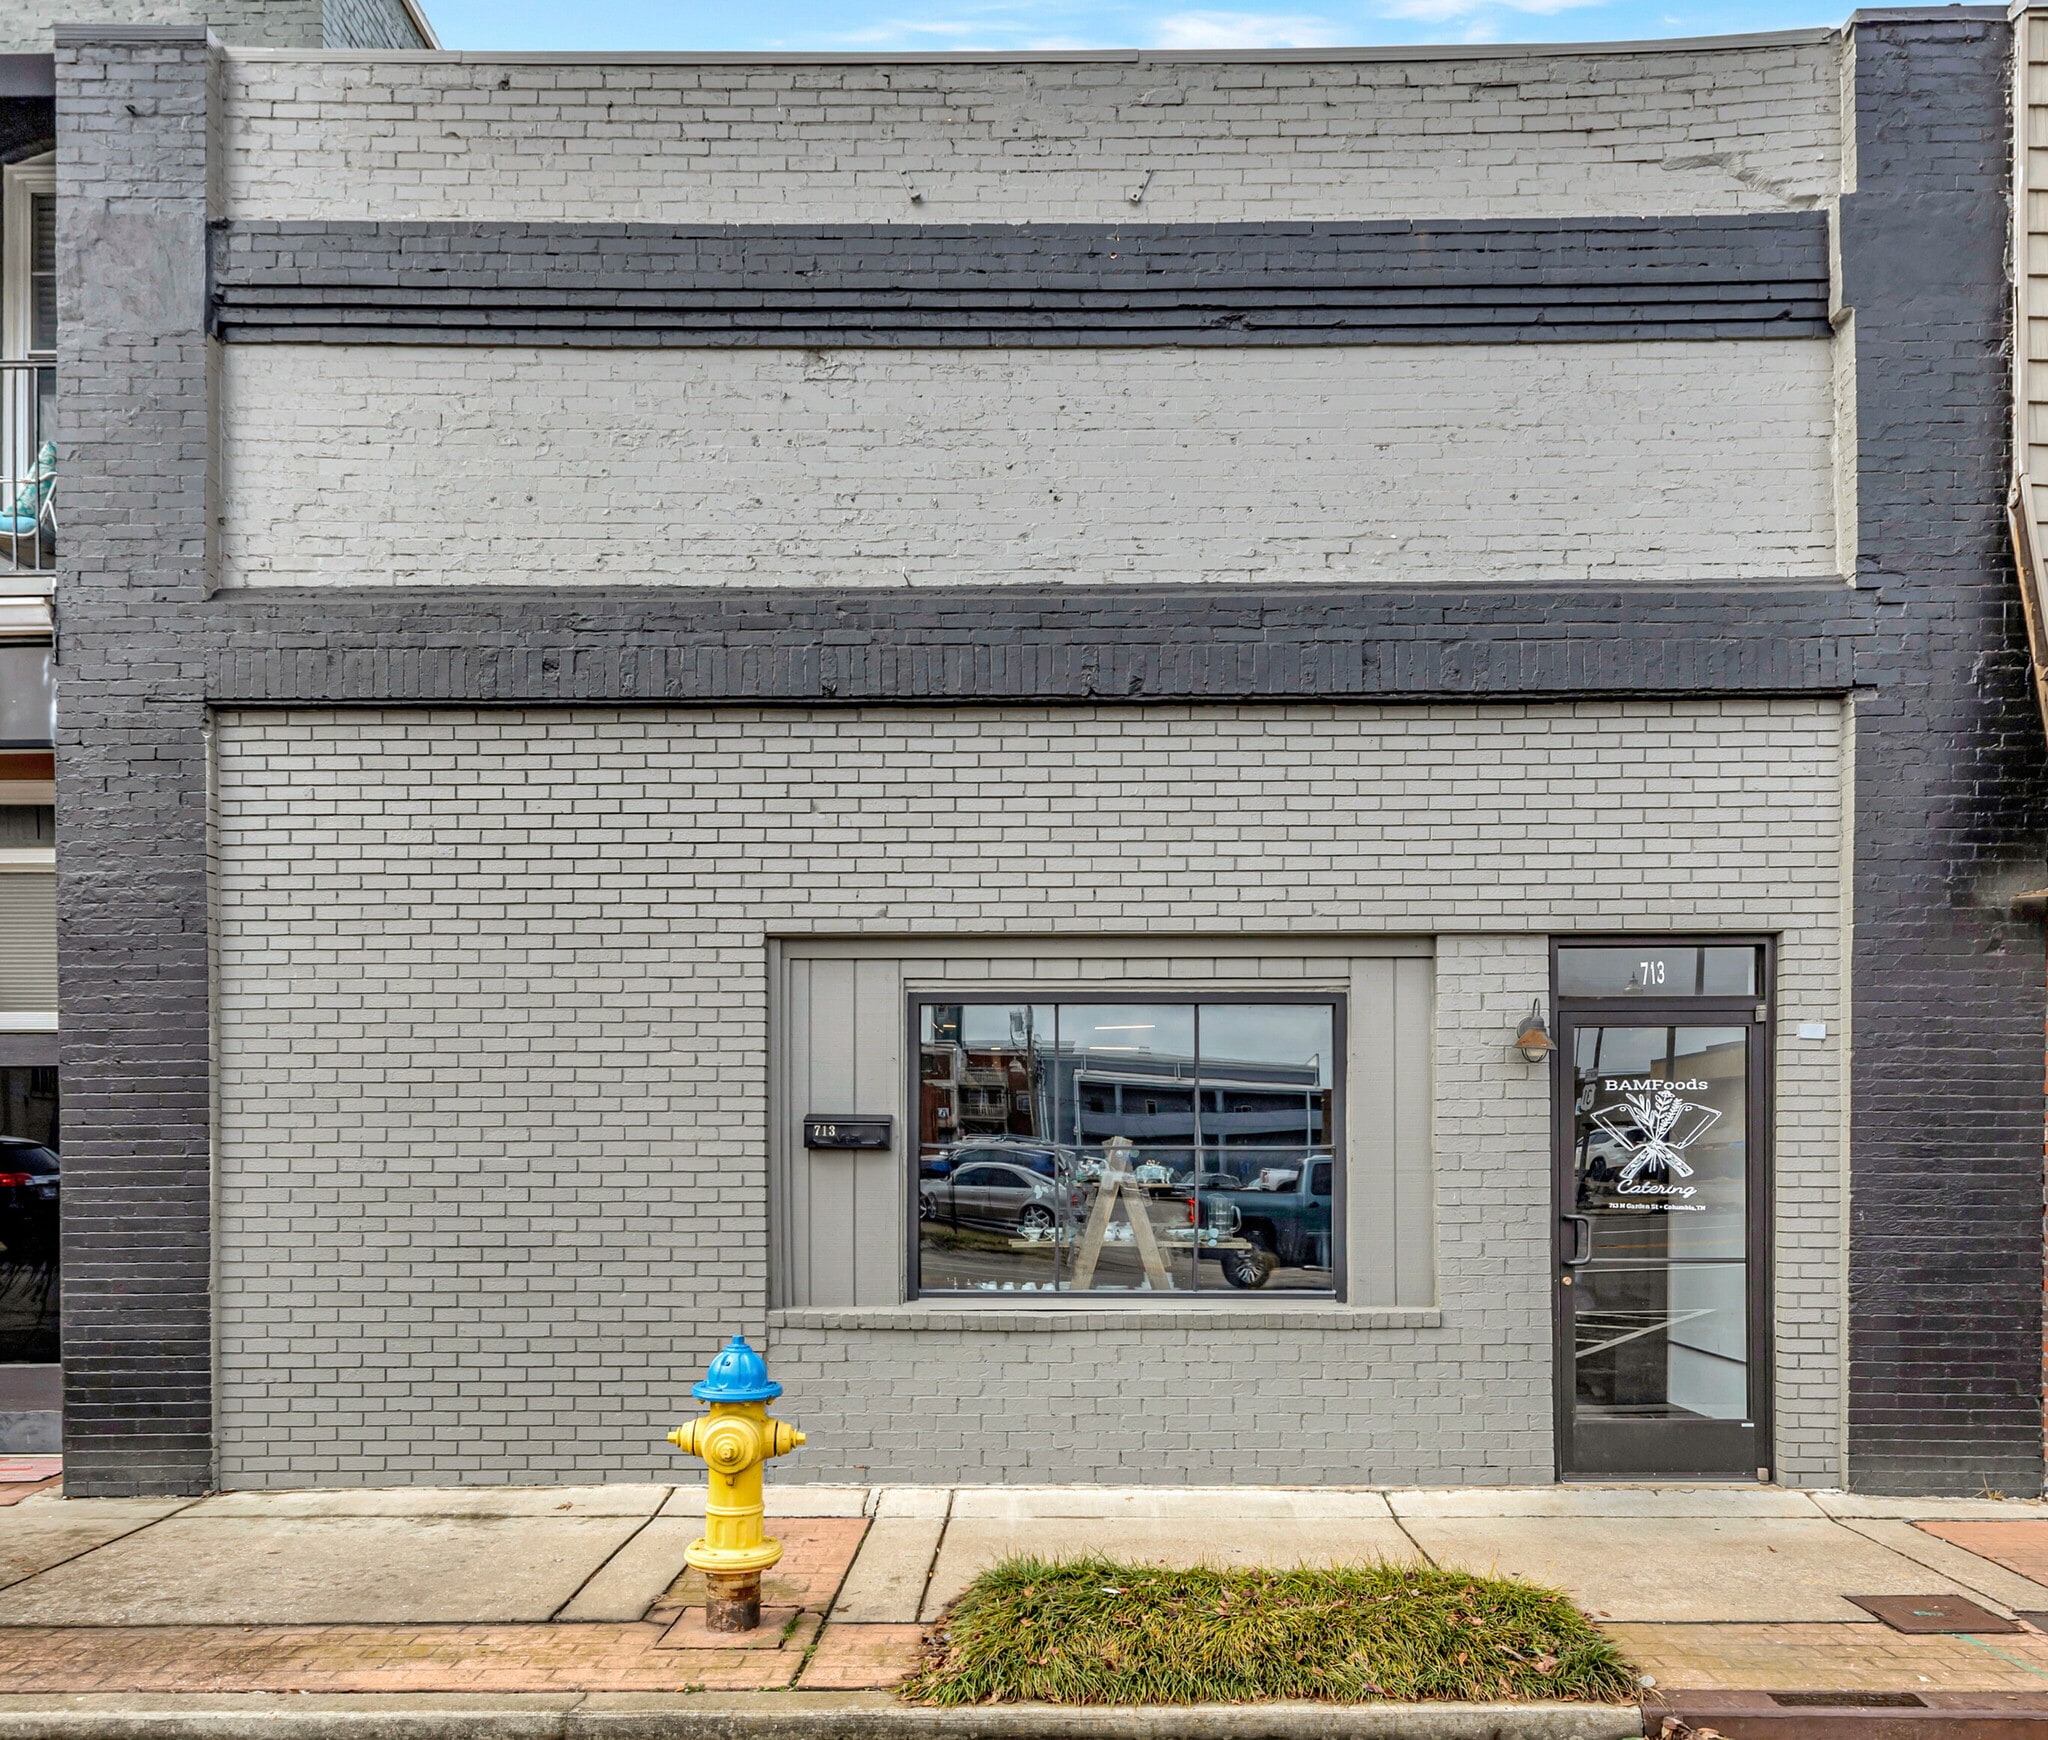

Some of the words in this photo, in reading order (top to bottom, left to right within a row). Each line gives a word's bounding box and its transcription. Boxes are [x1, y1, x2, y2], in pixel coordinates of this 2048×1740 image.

[1640, 960, 1665, 985] 713
[1604, 1078, 1709, 1091] BAMFoods
[814, 1125, 836, 1136] 713
[1617, 1179, 1697, 1199] Catering
